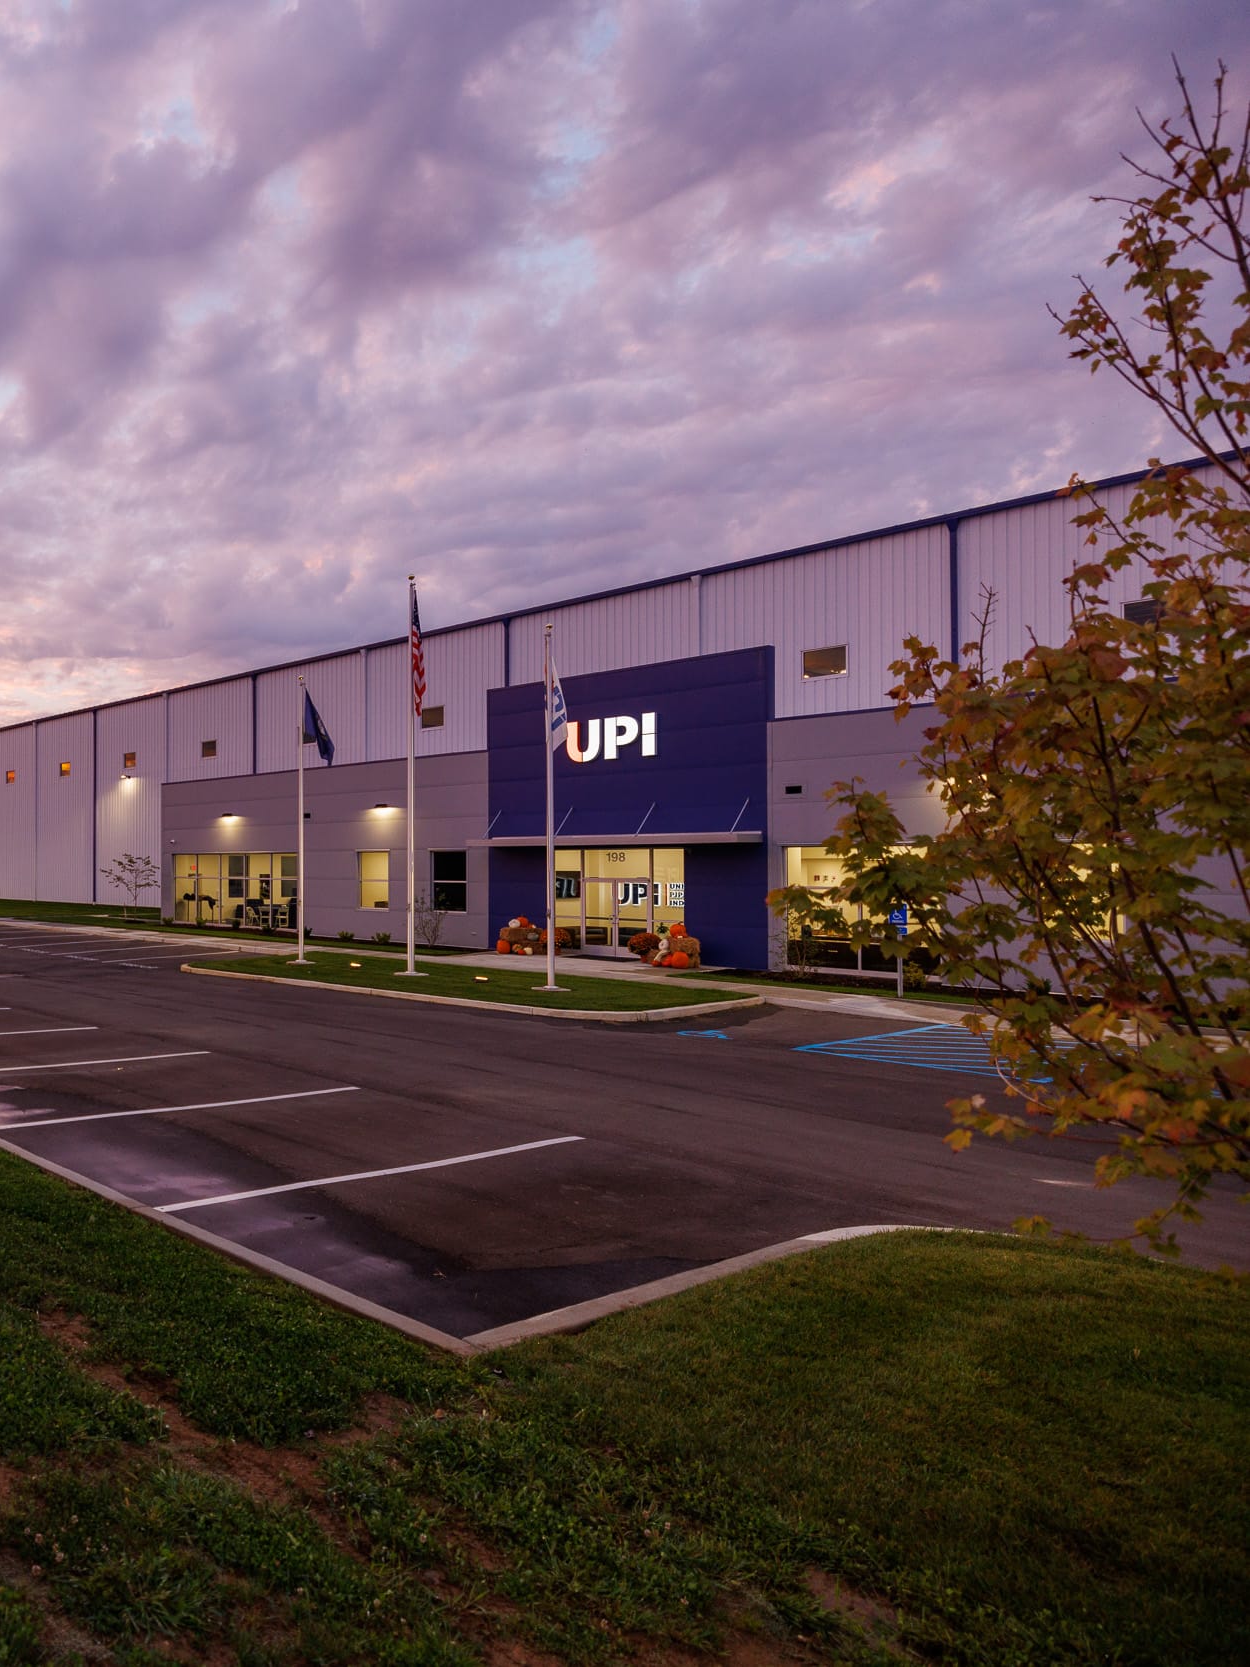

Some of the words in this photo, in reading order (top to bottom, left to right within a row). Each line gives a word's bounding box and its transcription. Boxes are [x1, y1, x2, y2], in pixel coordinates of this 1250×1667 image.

[566, 711, 657, 763] UPI
[605, 851, 626, 863] 198
[618, 882, 660, 906] UPI
